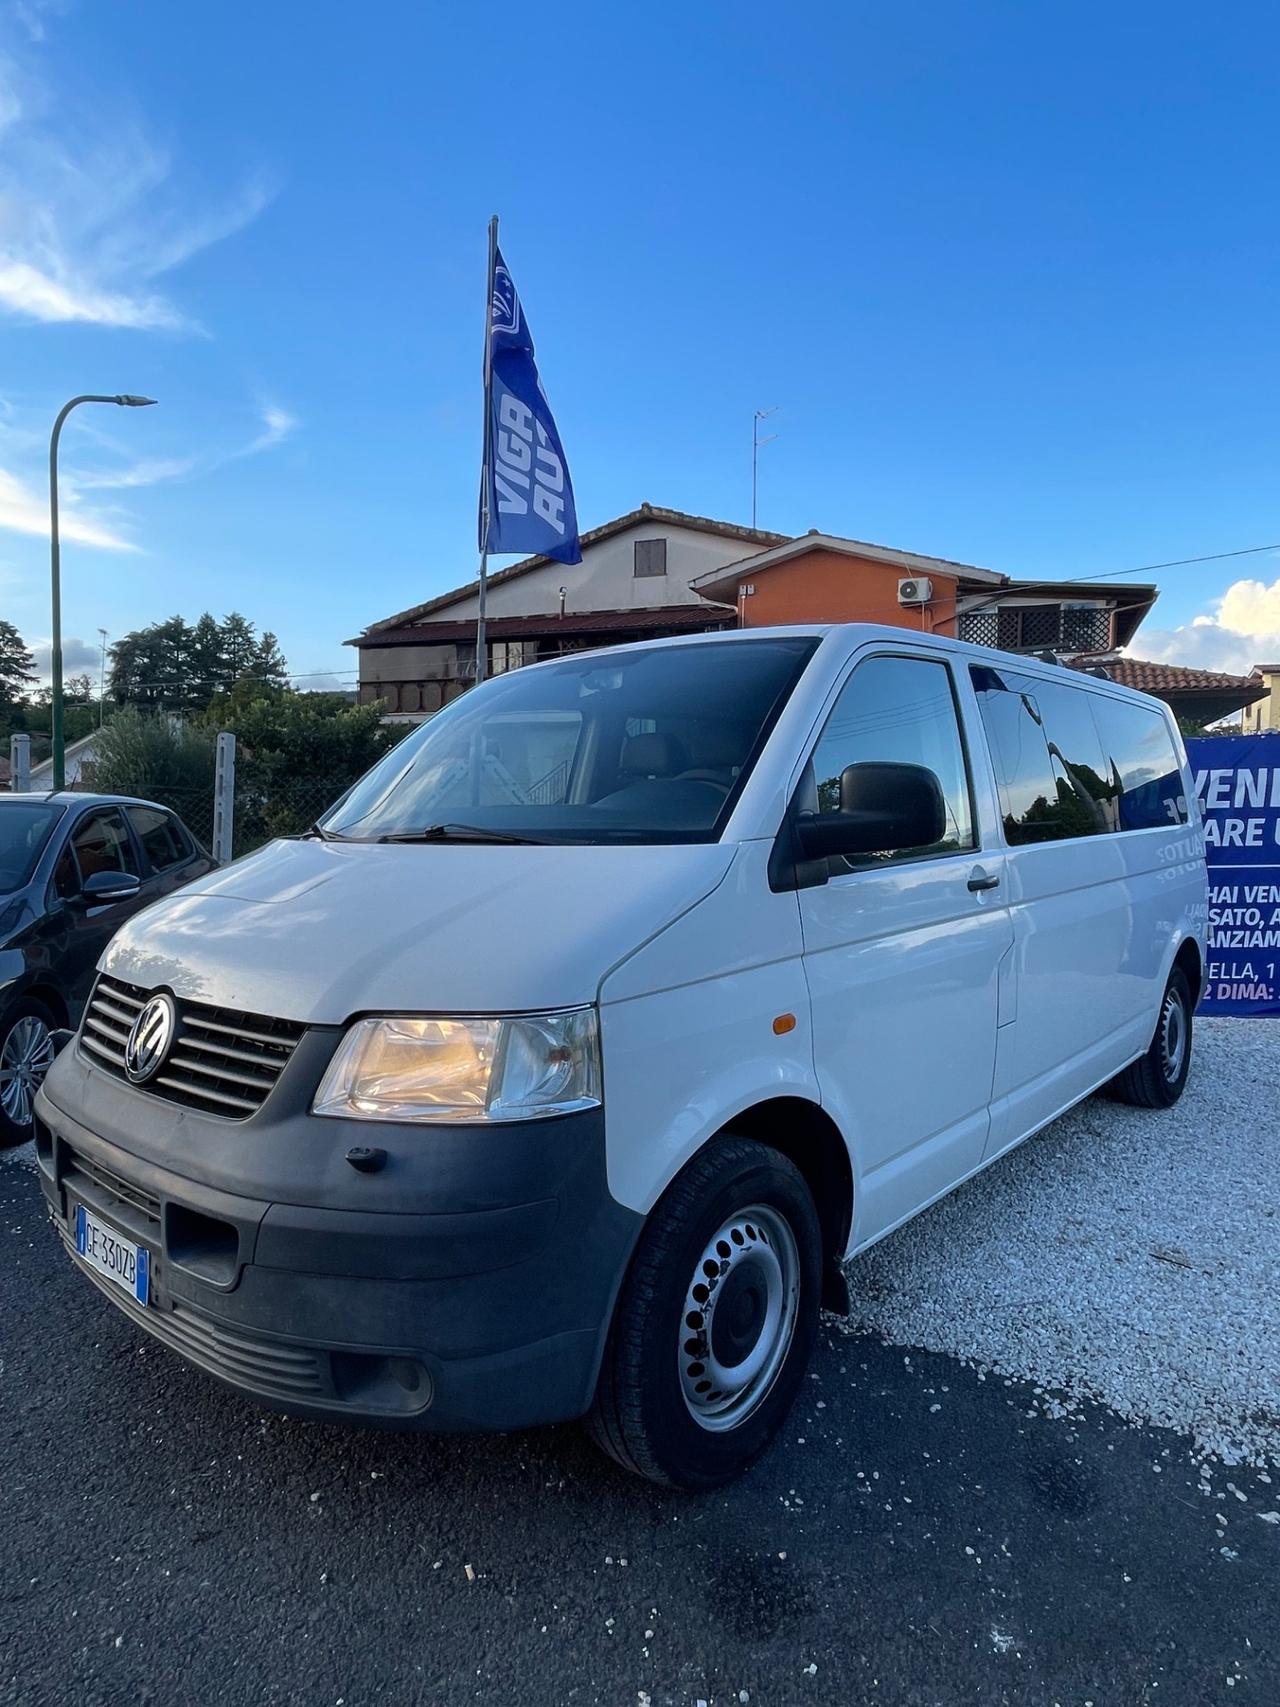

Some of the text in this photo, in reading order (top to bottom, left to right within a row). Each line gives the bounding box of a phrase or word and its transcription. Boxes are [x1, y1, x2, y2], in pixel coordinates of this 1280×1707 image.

[495, 393, 533, 515] VIGA
[1208, 908, 1265, 929] SATO,
[1206, 962, 1259, 982] ELLA,
[1216, 983, 1274, 1000] DIMA:
